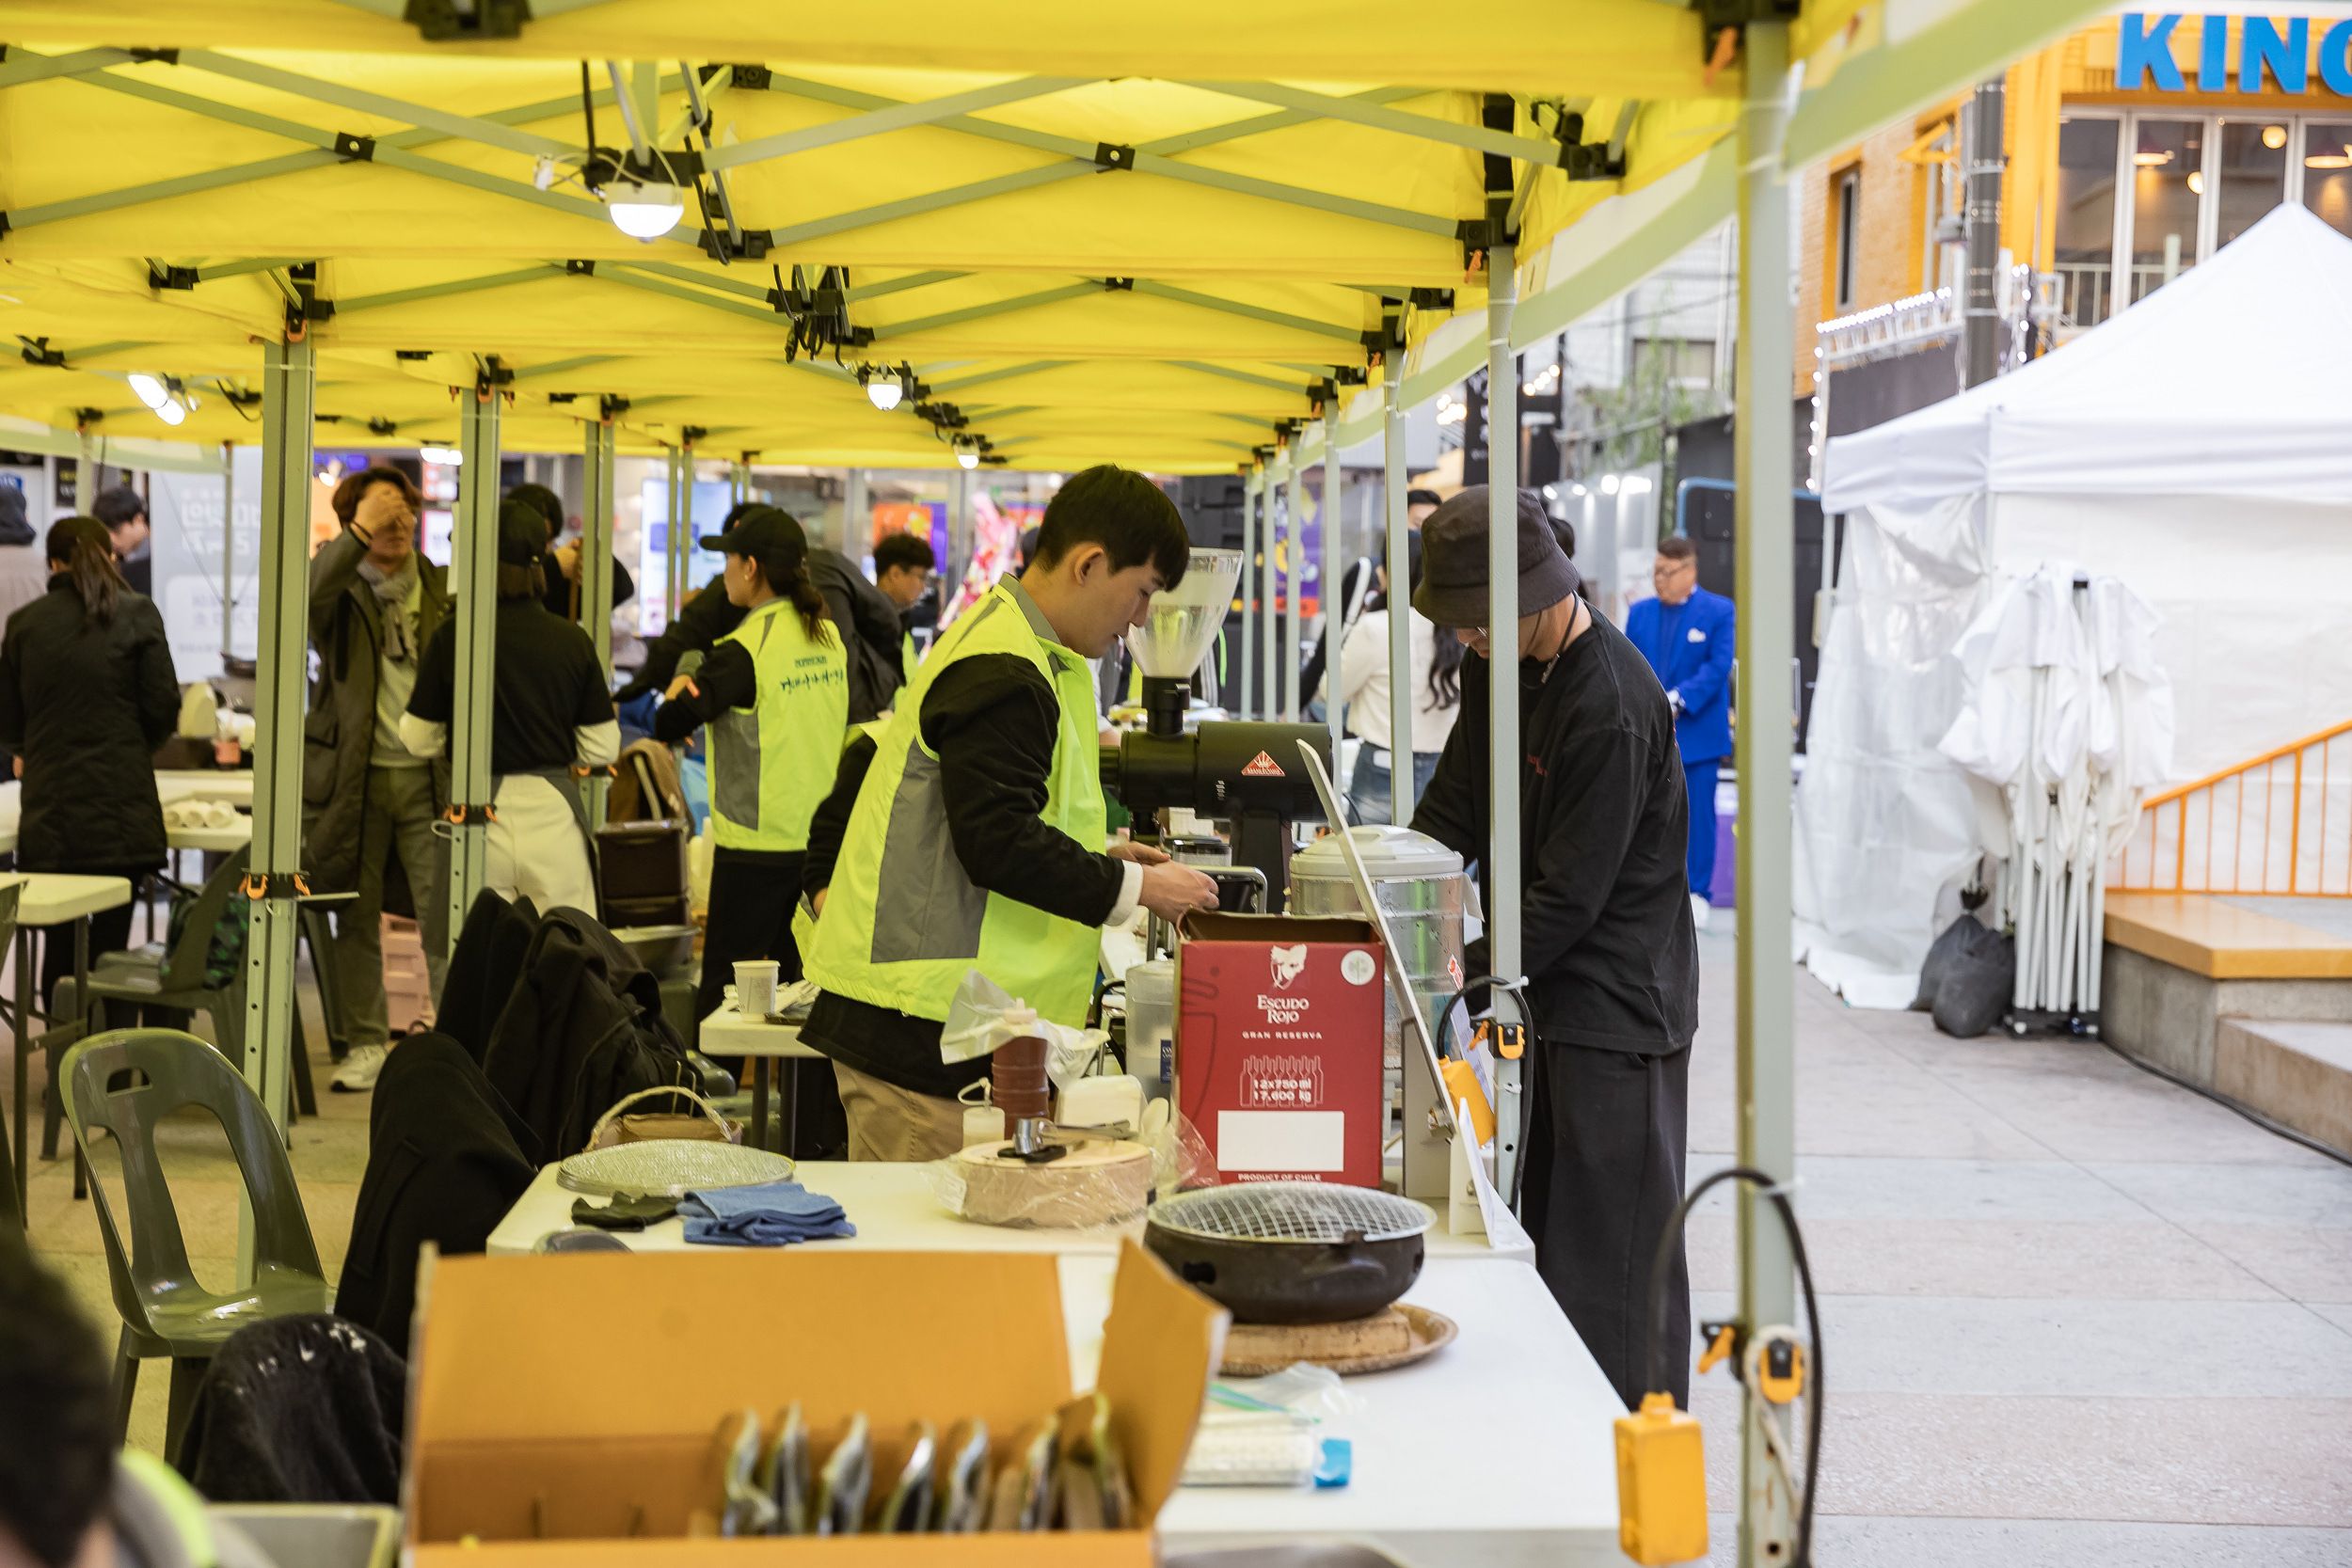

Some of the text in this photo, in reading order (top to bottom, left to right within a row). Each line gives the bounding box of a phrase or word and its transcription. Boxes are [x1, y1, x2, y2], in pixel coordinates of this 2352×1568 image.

[1242, 1031, 1323, 1039] GRAN RESERVA
[1298, 1090, 1311, 1103] kg
[1237, 1173, 1322, 1181] PRODUCT OF CHILE
